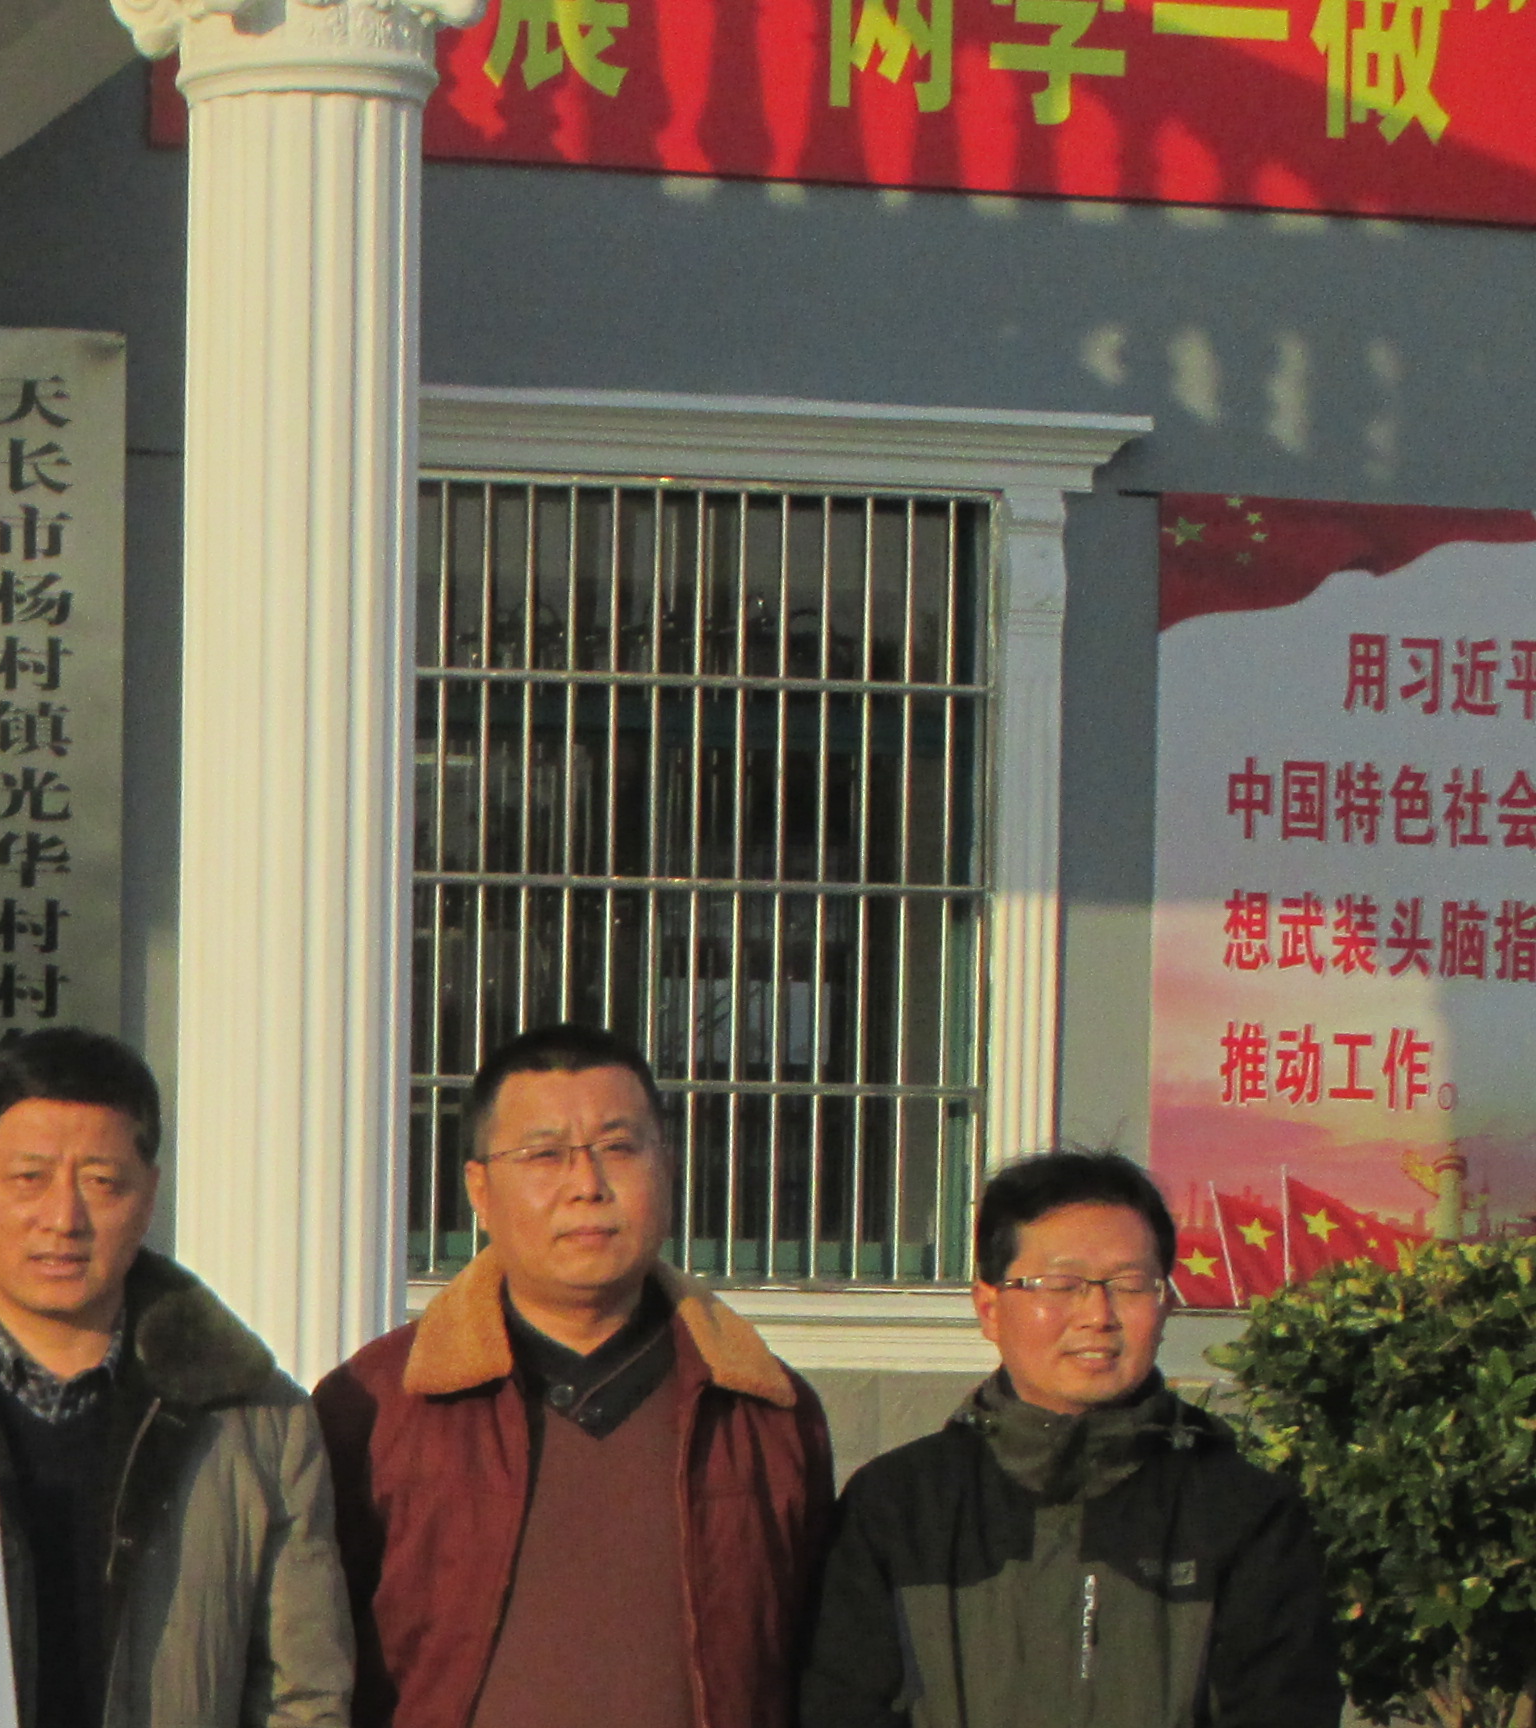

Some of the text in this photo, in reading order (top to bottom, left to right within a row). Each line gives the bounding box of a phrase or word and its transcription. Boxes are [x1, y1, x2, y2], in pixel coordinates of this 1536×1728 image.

[1342, 632, 1536, 721] 用习近平
[1226, 757, 1536, 850] 中国特色社会
[1222, 889, 1536, 983] 想武装头脑指
[1220, 1020, 1458, 1112] 推动工作。
